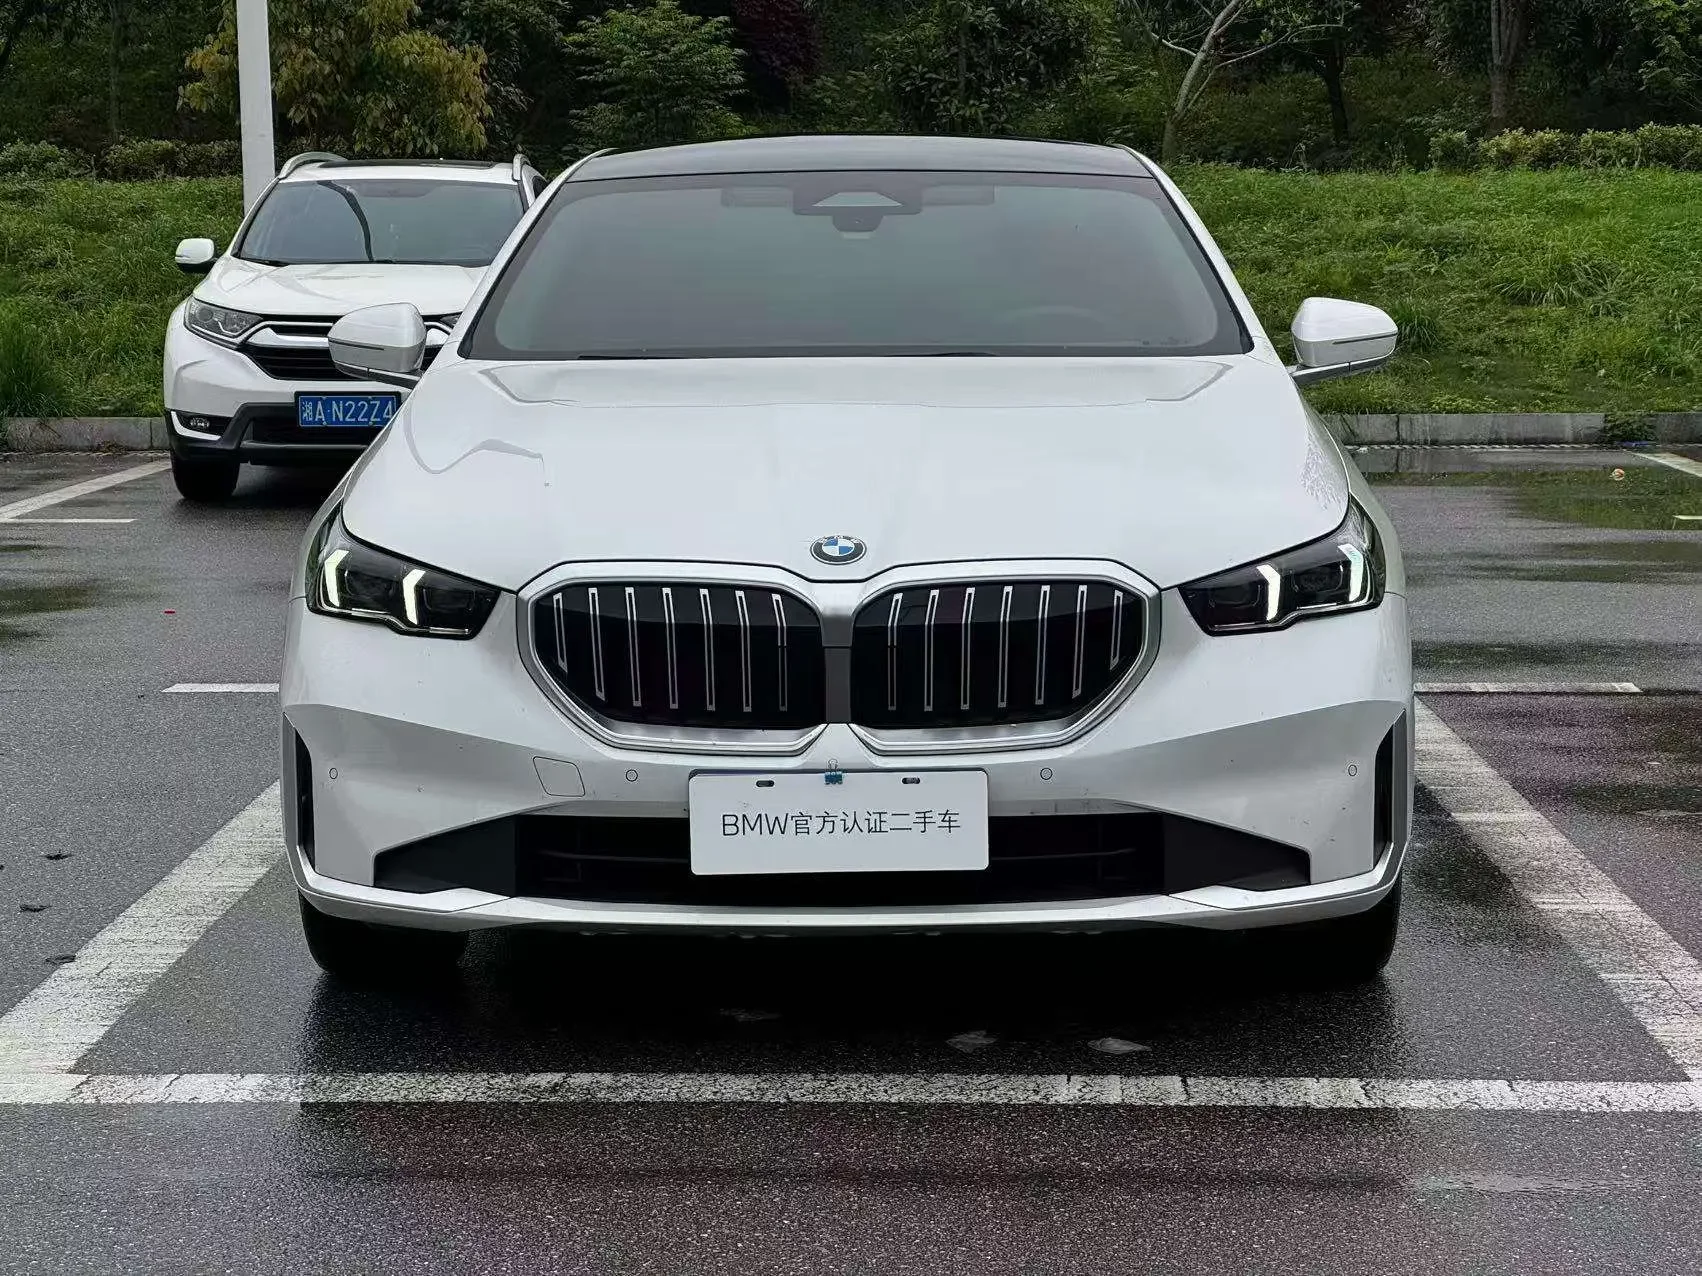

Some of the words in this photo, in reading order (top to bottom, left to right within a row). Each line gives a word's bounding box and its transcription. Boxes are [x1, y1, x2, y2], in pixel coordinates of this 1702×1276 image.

[721, 809, 961, 836] BMW官方认证二手车
